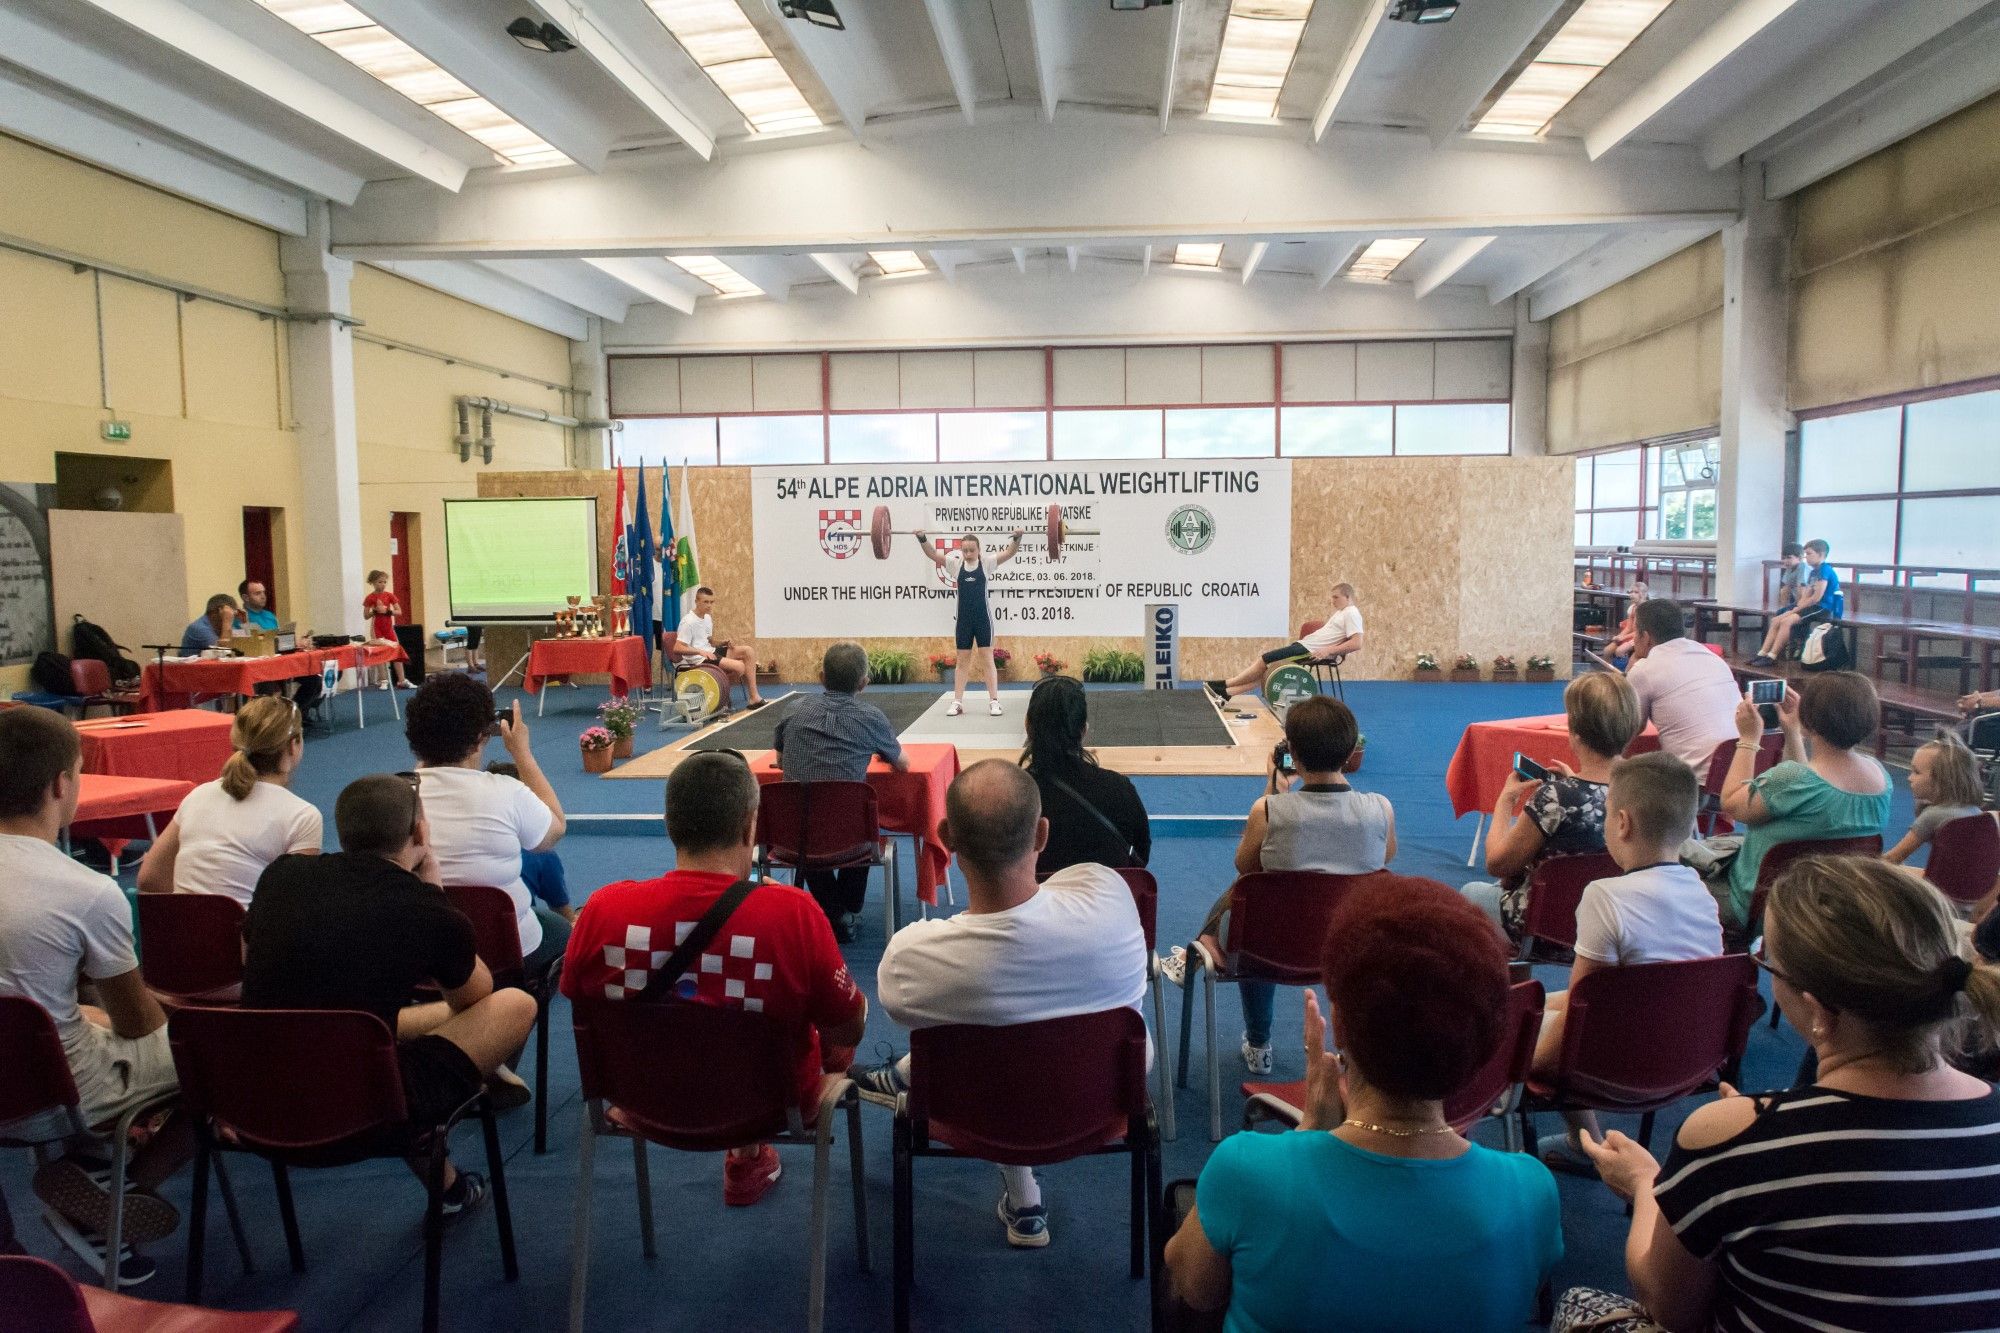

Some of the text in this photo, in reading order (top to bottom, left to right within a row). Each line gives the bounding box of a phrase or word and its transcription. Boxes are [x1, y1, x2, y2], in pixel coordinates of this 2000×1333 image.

[809, 476, 860, 499] ALPE
[866, 475, 929, 498] ADRIA
[934, 473, 1095, 497] INTERNATIONAL
[1100, 471, 1260, 494] WEIGHTLIFTING
[935, 505, 1091, 521] PRVENSTVO REPUBLIKE HVATSKE
[985, 544, 997, 553] ZA
[999, 543, 1033, 552] KETE
[1040, 543, 1094, 552] KAETKINJE
[1015, 556, 1037, 564] U-15
[1037, 572, 1051, 581] 03.
[1054, 572, 1068, 581] 06.
[1070, 572, 1096, 581] 2018.
[784, 586, 828, 601] UNDER
[832, 586, 857, 600] THE
[860, 585, 891, 600] HIGH
[895, 585, 957, 600] PATRONA
[1029, 585, 1101, 599] PRESIDENT
[1105, 583, 1123, 597] OF
[1127, 582, 1193, 597] REPUBLIC
[1201, 582, 1260, 597] CROATIA
